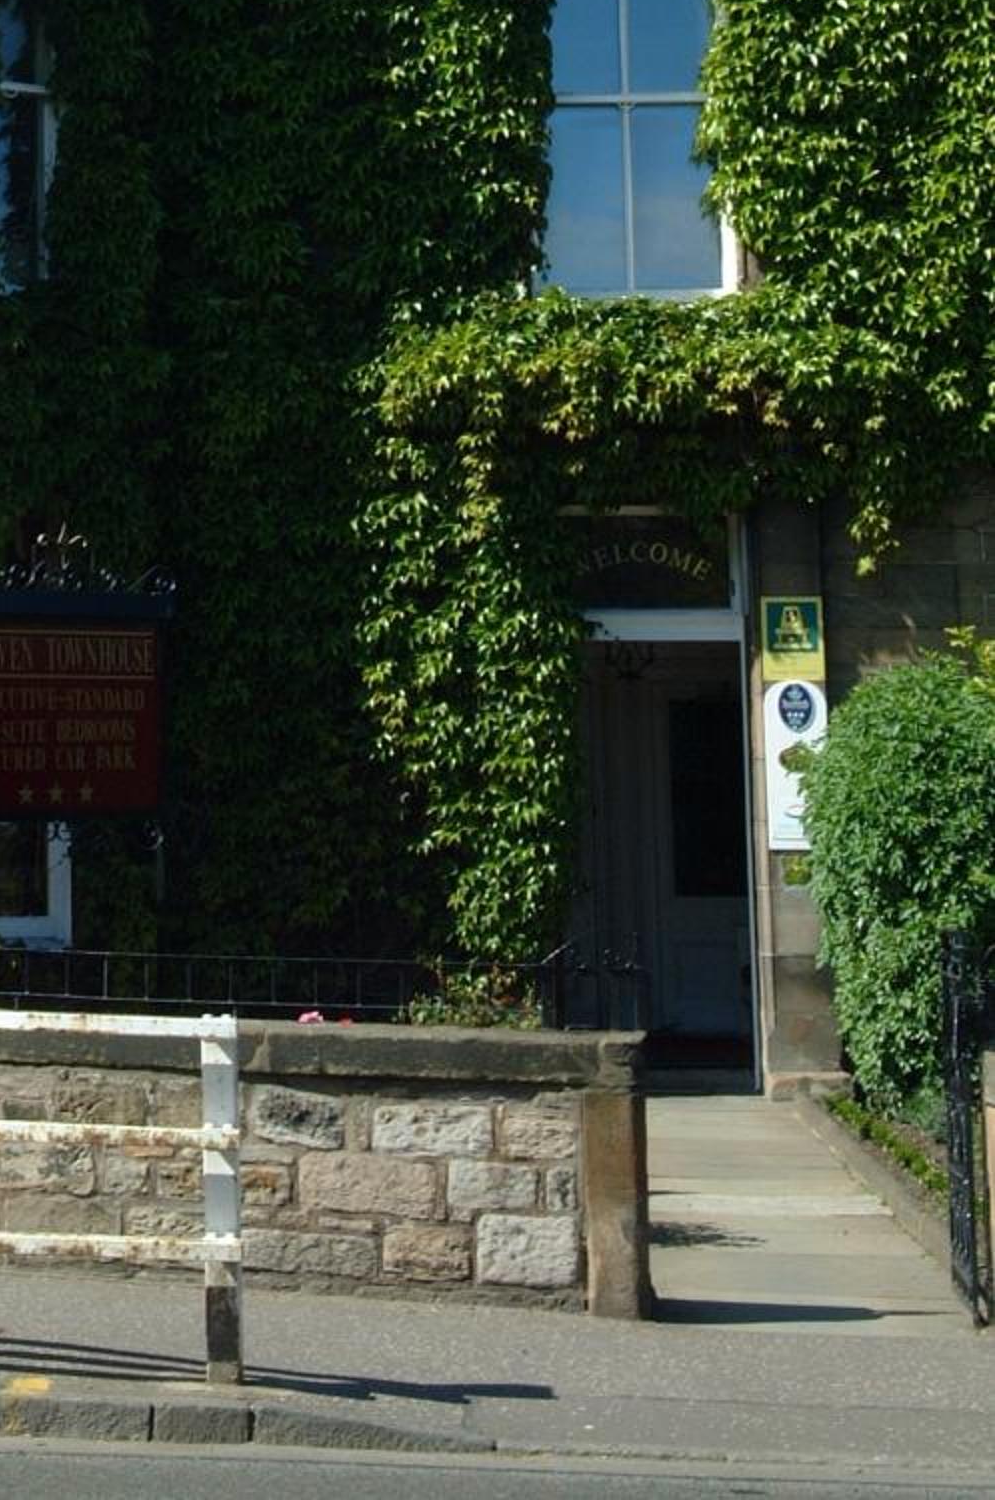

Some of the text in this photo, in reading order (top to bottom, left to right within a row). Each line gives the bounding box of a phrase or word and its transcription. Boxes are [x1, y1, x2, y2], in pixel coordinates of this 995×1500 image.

[45, 637, 154, 674] TOWNHOUSE
[56, 719, 136, 742] BEDROOMS
[55, 747, 85, 770] CAR
[95, 745, 136, 770] PARK
